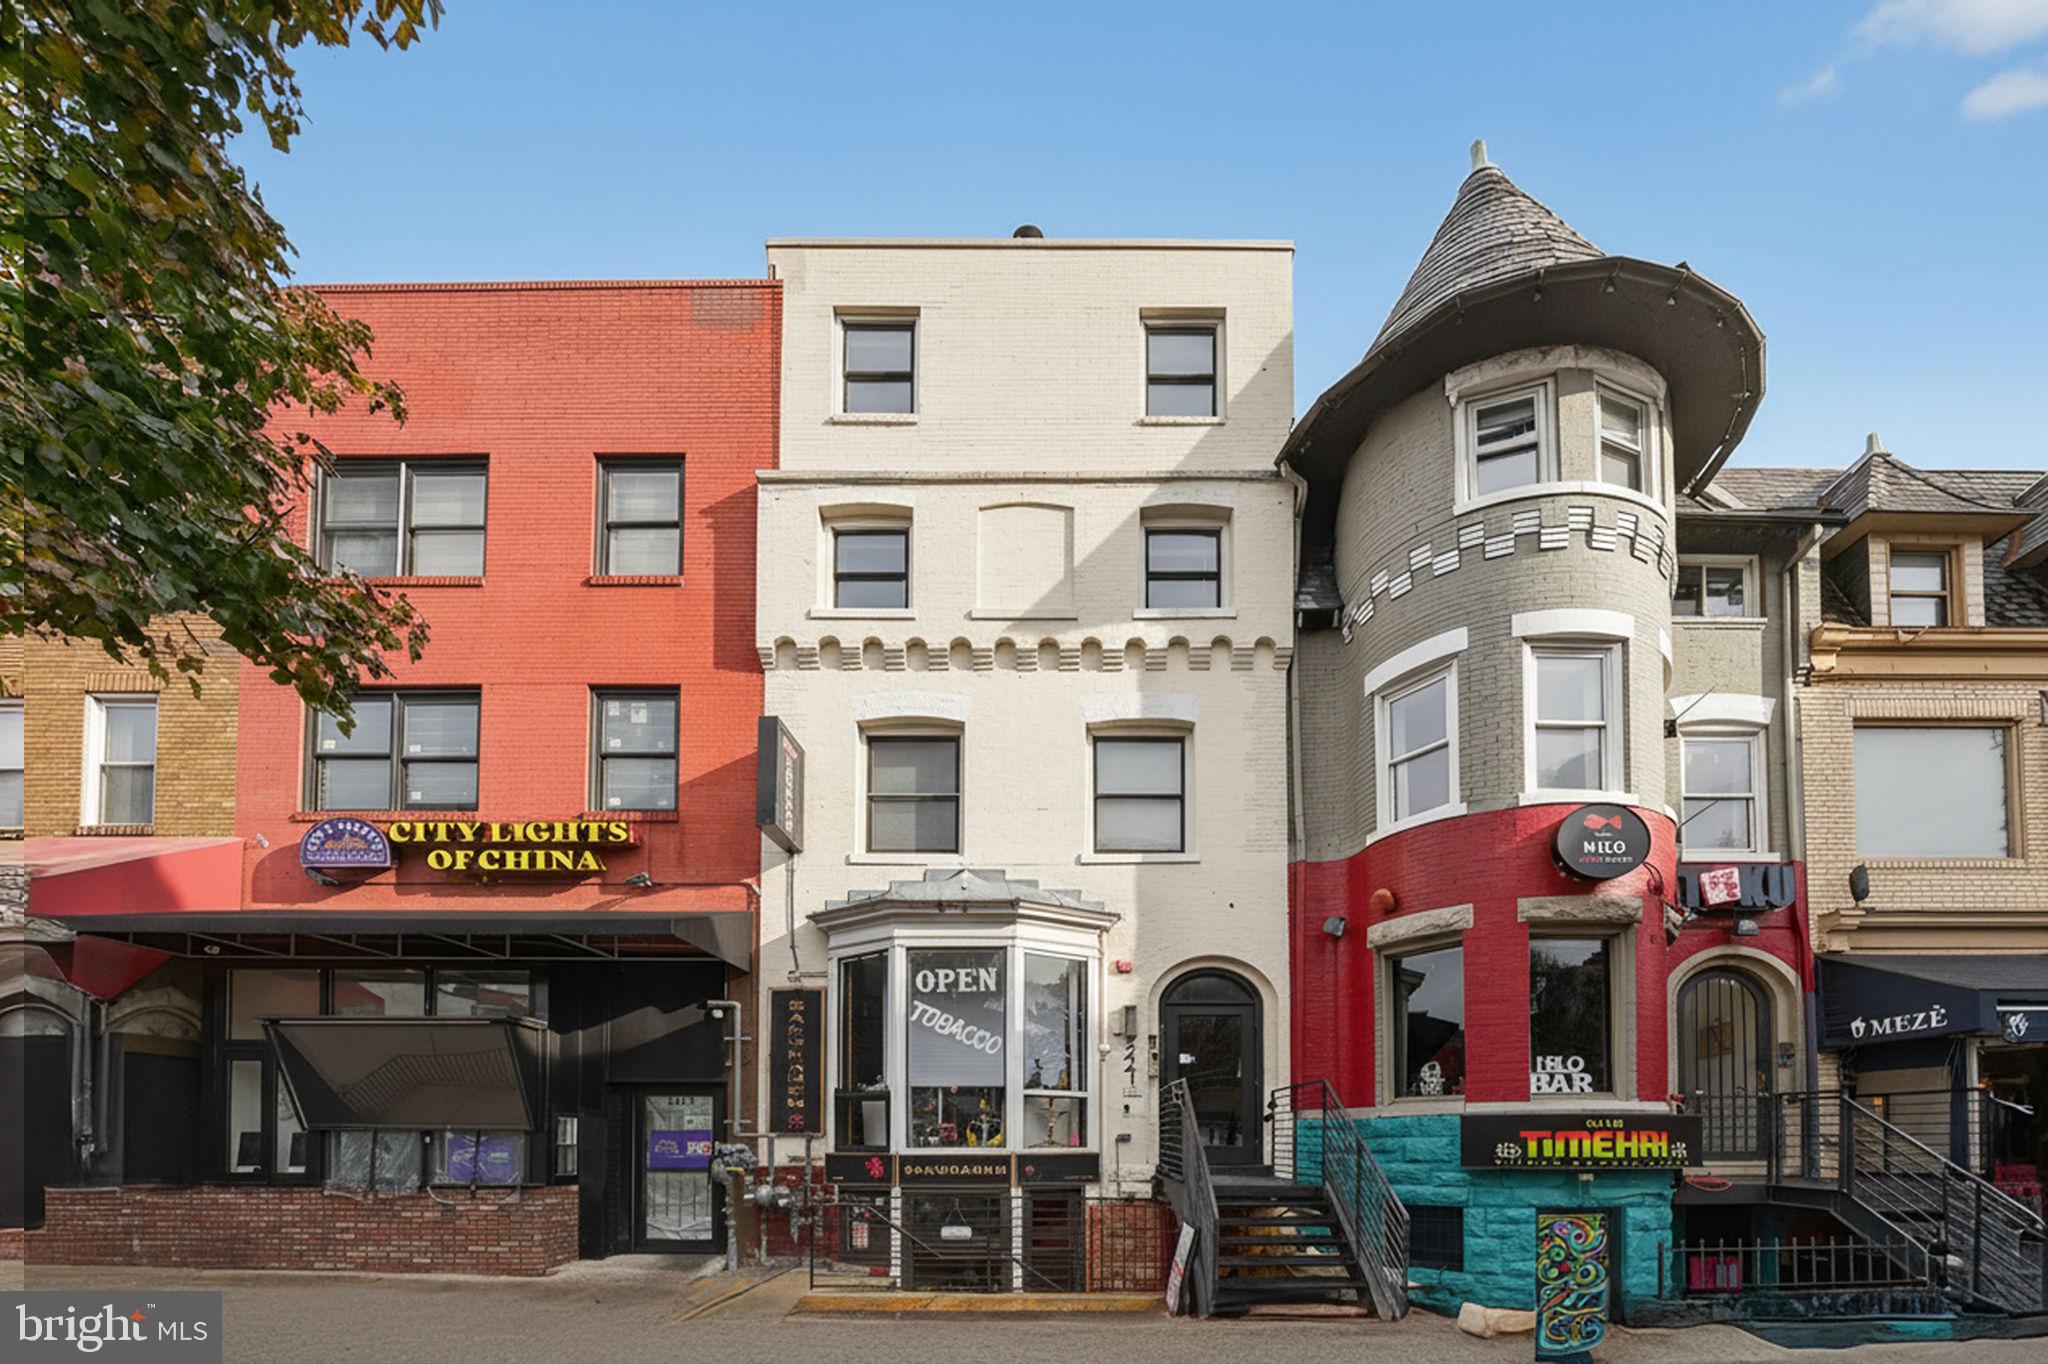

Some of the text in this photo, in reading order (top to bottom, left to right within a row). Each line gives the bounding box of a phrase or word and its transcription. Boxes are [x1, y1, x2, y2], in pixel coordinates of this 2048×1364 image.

[389, 822, 481, 842] CITY
[491, 822, 628, 842] LIGHTS
[427, 849, 607, 870] OF CHINA
[915, 967, 998, 993] OPEN
[1530, 1072, 1594, 1093] BAR
